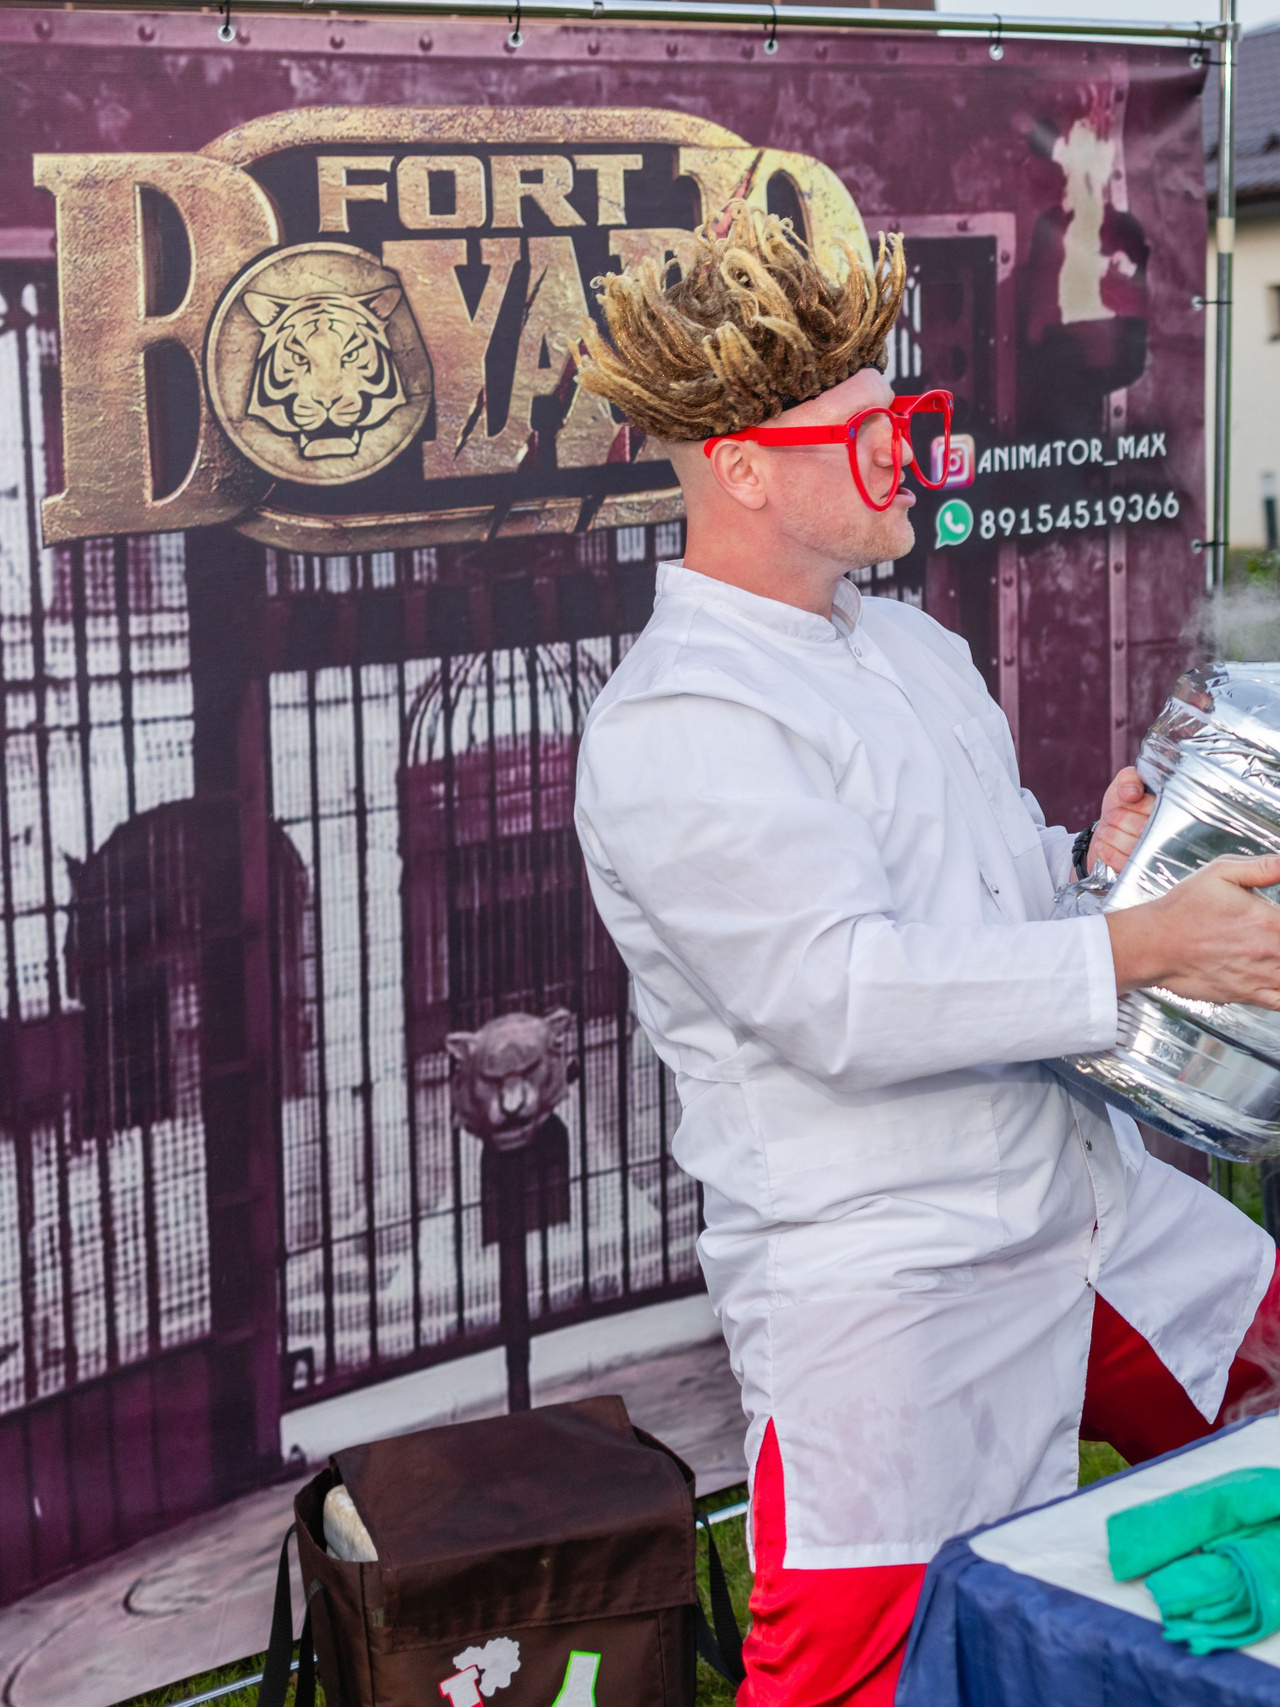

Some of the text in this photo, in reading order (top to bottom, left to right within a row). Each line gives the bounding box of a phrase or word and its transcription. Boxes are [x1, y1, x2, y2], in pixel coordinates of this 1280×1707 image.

[316, 154, 643, 234] FORT
[977, 432, 1167, 474] ANIMATOR_MAX
[980, 491, 1180, 540] 89154519366
